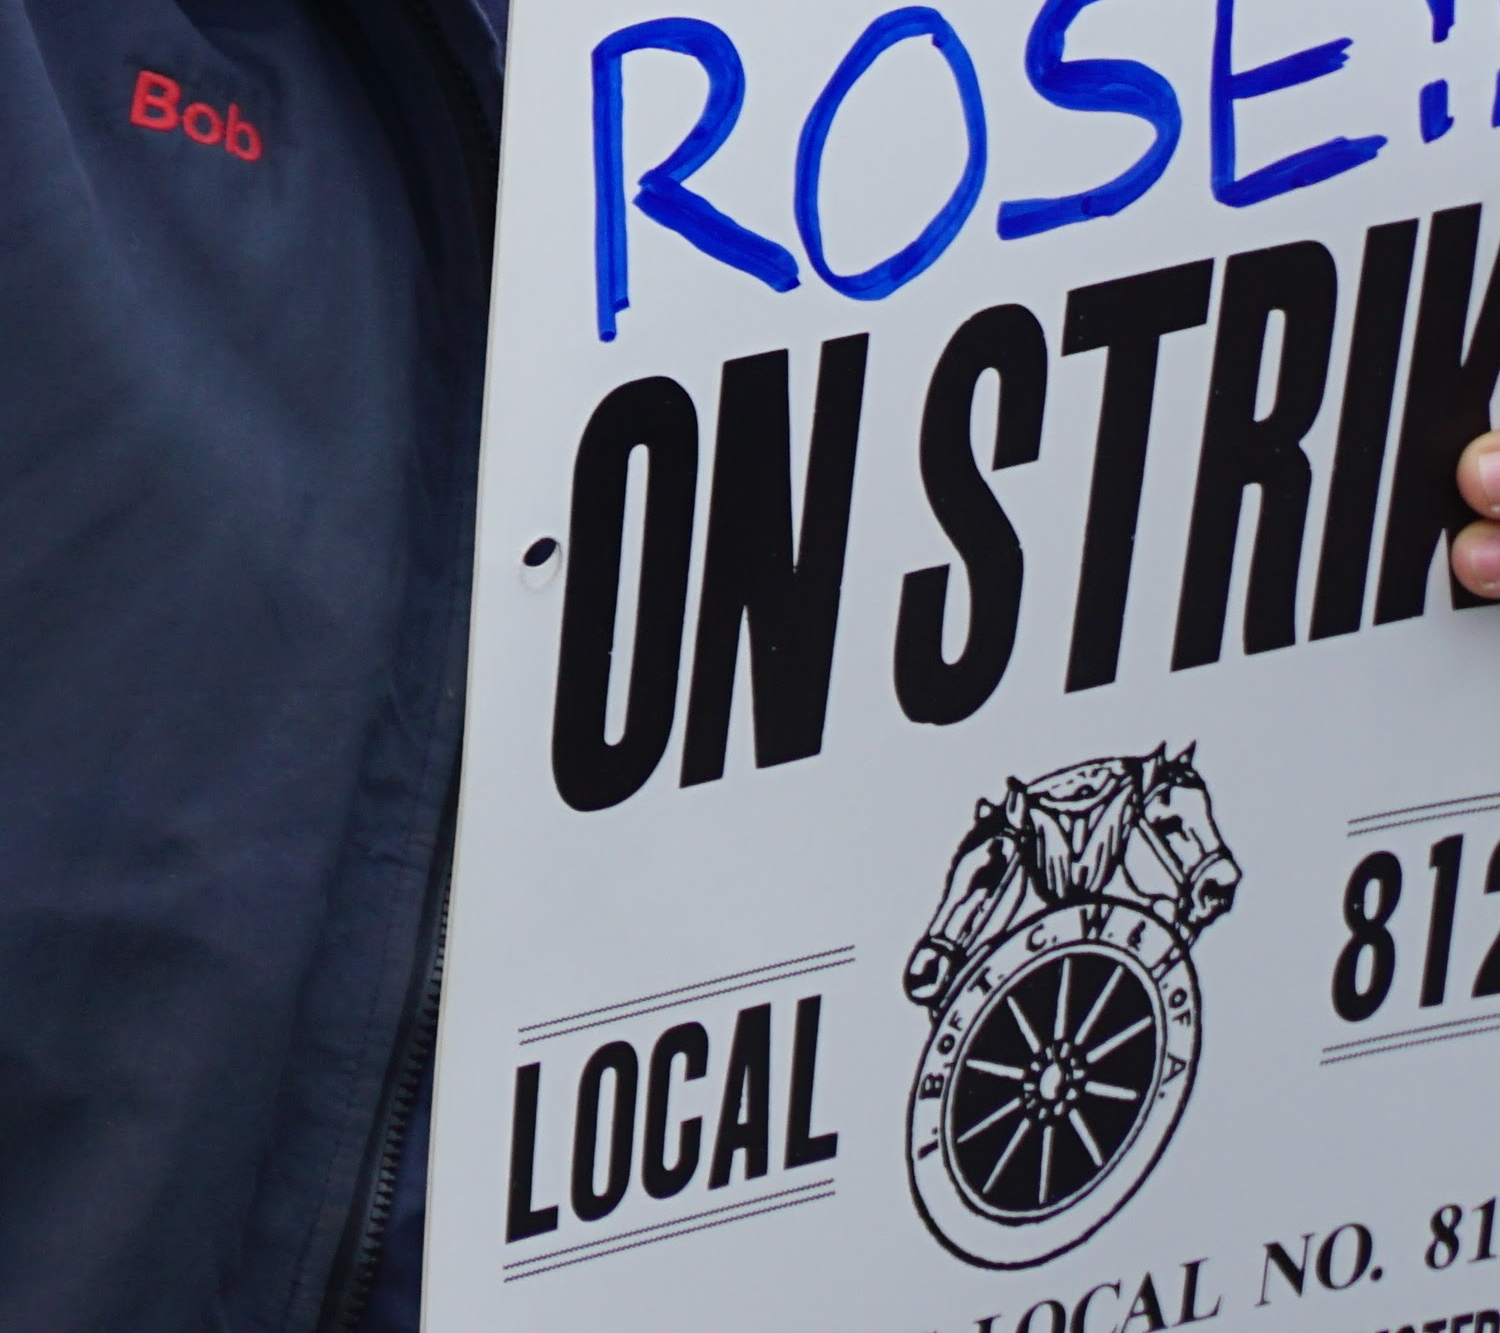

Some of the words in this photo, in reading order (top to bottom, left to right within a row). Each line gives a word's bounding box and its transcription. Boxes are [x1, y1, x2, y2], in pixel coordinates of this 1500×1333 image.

[130, 69, 263, 161] Bob
[551, 332, 869, 812] ON
[507, 994, 839, 1244] LOCAL
[973, 1258, 1222, 1333] OCAL
[1255, 1223, 1383, 1307] NO.
